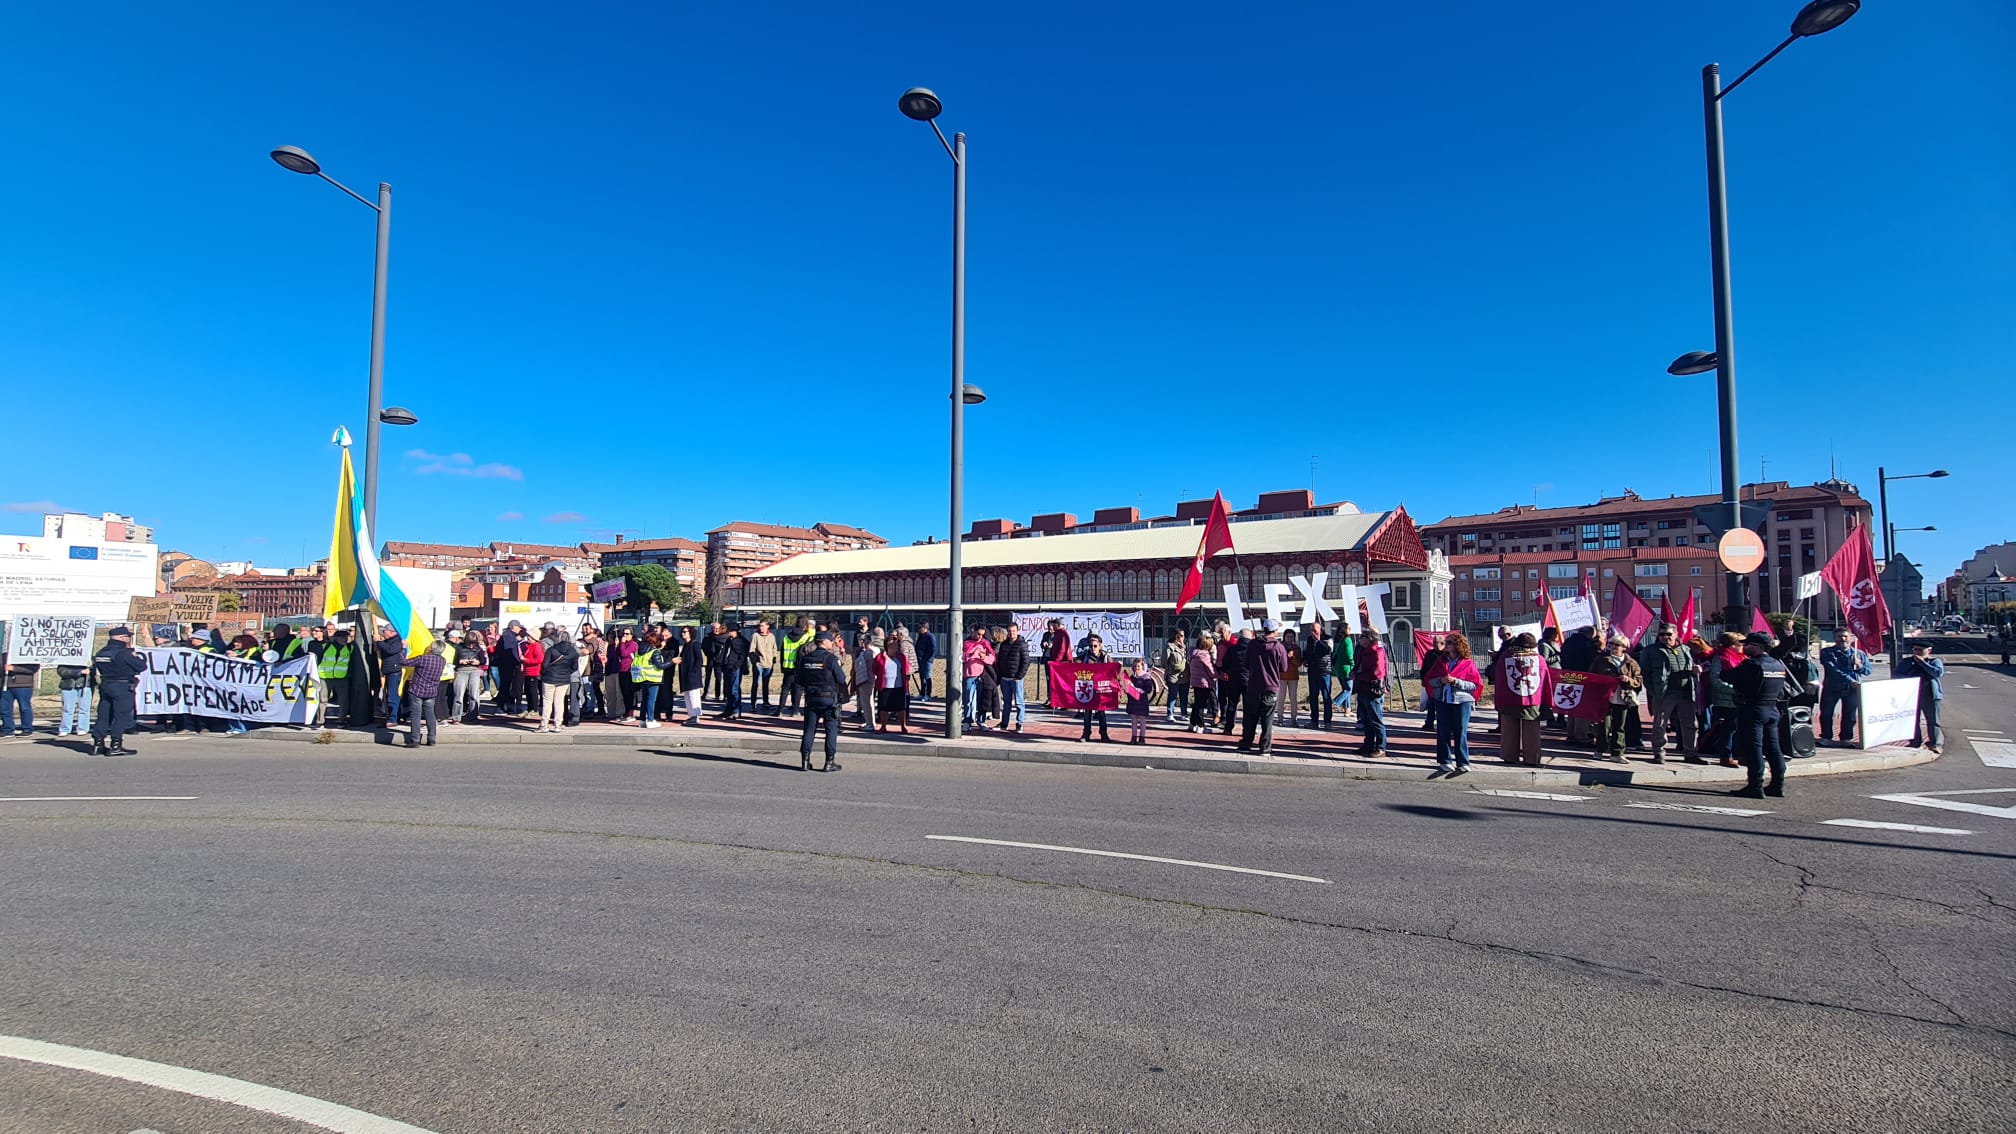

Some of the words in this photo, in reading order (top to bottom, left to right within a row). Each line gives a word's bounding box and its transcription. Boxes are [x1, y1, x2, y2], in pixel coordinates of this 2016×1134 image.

[185, 594, 215, 604] VUELVE
[1223, 572, 1391, 635] LEXIT
[173, 603, 213, 611] TRENECITO
[176, 611, 211, 620] VUELVE
[20, 617, 33, 628] SI
[54, 619, 89, 629] TRAEIS
[21, 628, 36, 637] LA
[41, 629, 87, 639] SOLUCION
[24, 638, 44, 647] AHI
[19, 647, 33, 656] LA
[36, 647, 83, 657] ESTACION
[144, 691, 162, 704] EN
[167, 683, 253, 714] DEFENSA
[253, 700, 267, 712] DE
